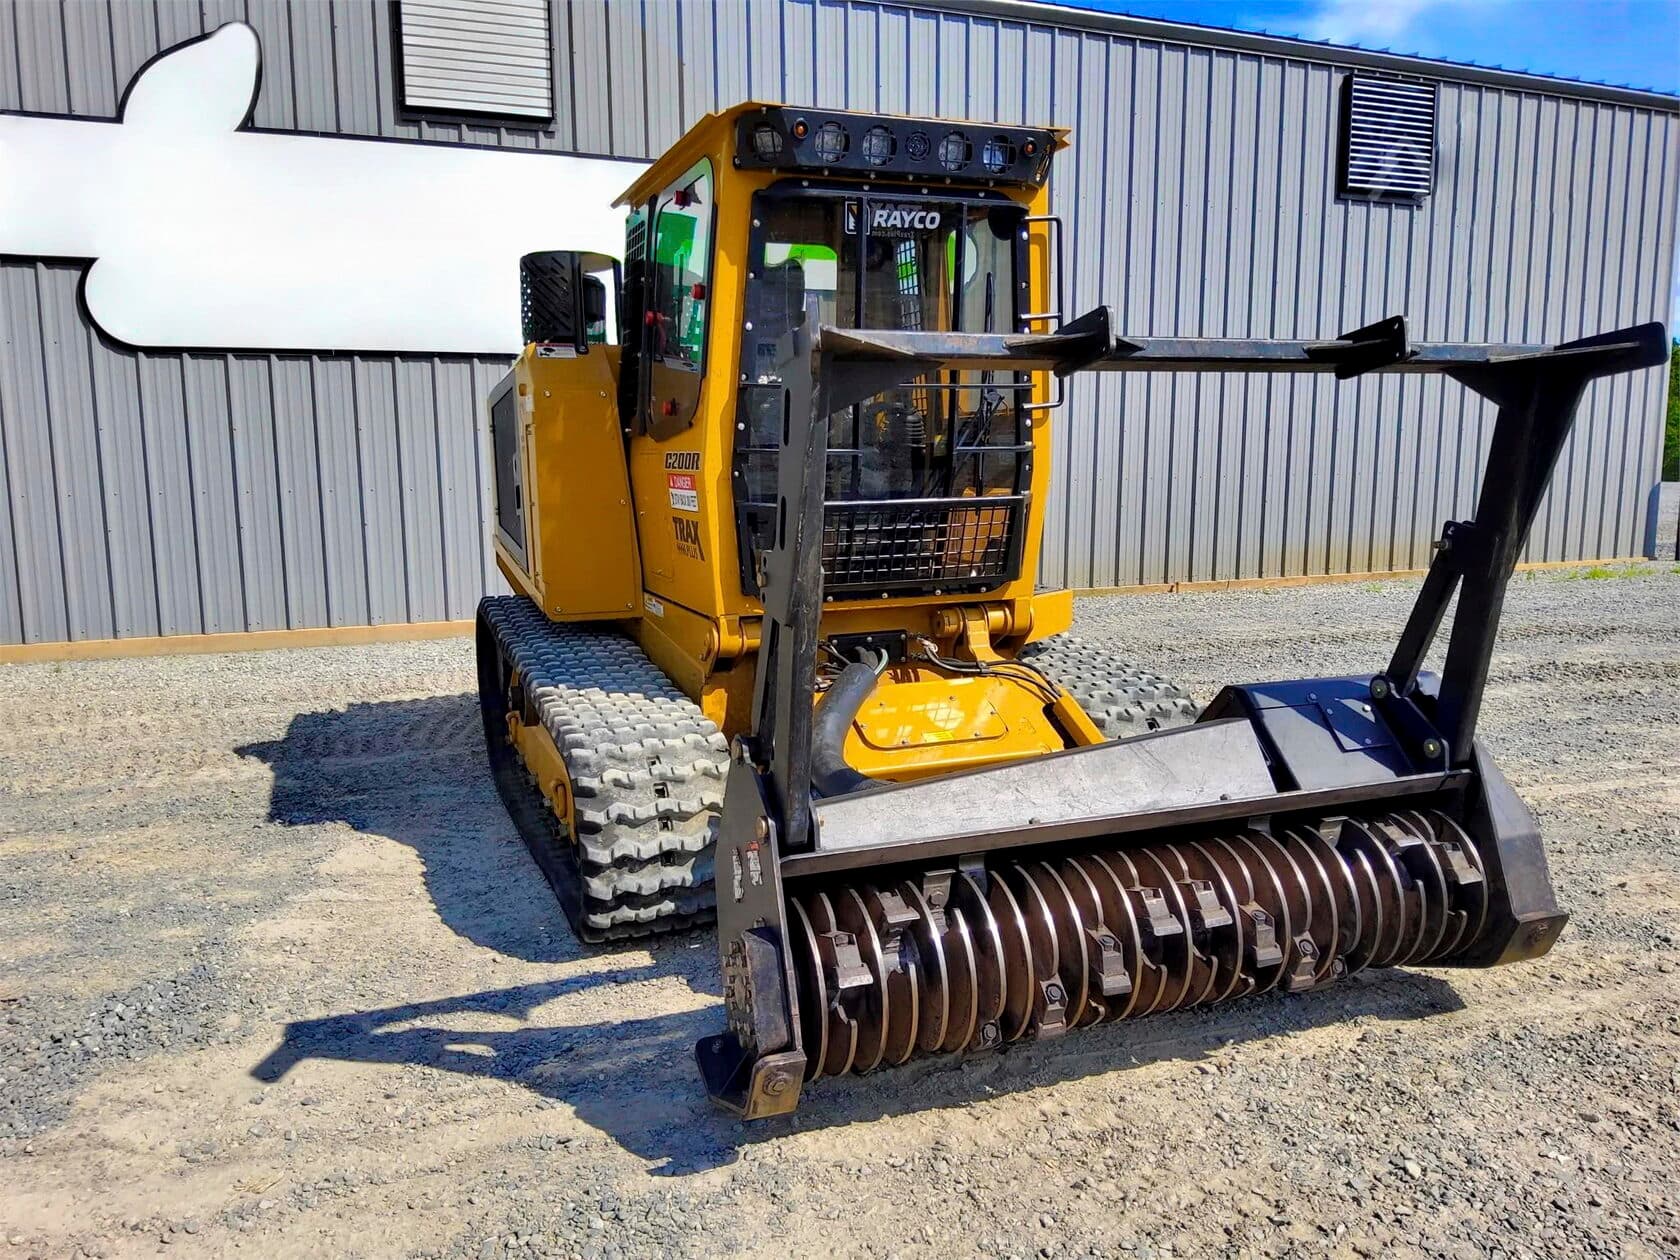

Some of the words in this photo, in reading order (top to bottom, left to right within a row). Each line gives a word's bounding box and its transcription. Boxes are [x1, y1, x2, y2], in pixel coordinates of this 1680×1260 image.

[872, 210, 941, 230] RAYCO
[665, 452, 700, 470] C200R
[672, 516, 705, 562] TRAX
